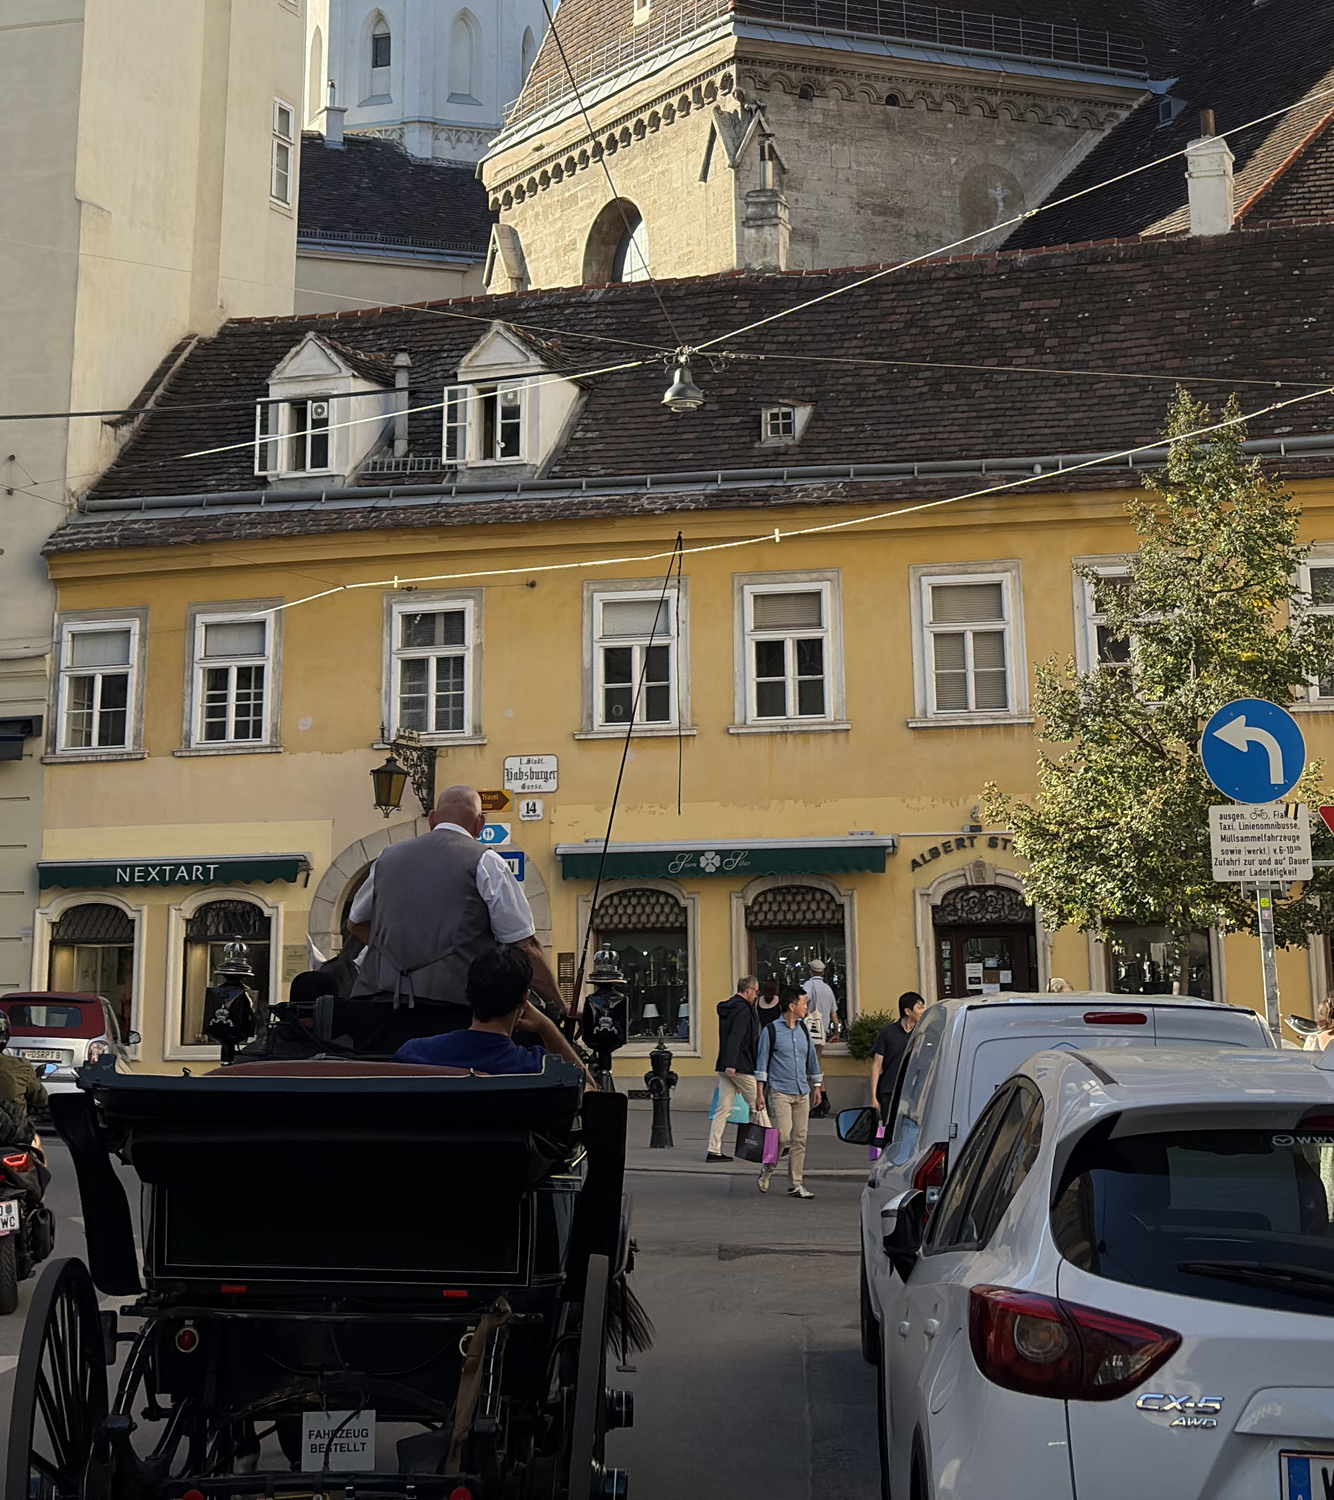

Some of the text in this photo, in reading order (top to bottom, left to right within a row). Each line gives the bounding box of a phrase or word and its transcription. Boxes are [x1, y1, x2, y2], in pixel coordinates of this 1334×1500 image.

[505, 766, 557, 783] Habsburger
[525, 802, 537, 814] 14
[1219, 813, 1247, 822] ausgen.
[1220, 833, 1300, 843] Müllsammelfahrzeuge
[911, 836, 1016, 872] ALBERT ST
[1220, 848, 1242, 856] sowie
[1214, 857, 1241, 866] Zufahrt
[1243, 858, 1255, 866] zur
[1258, 857, 1271, 866] und
[1288, 856, 1310, 865] Dauer
[116, 864, 220, 883] NEXTART
[1228, 867, 1297, 878] einer Ladetätigkeit
[1136, 1393, 1225, 1415] CX-5
[1170, 1416, 1218, 1430] AWD
[308, 1428, 369, 1440] FAHRZEUG
